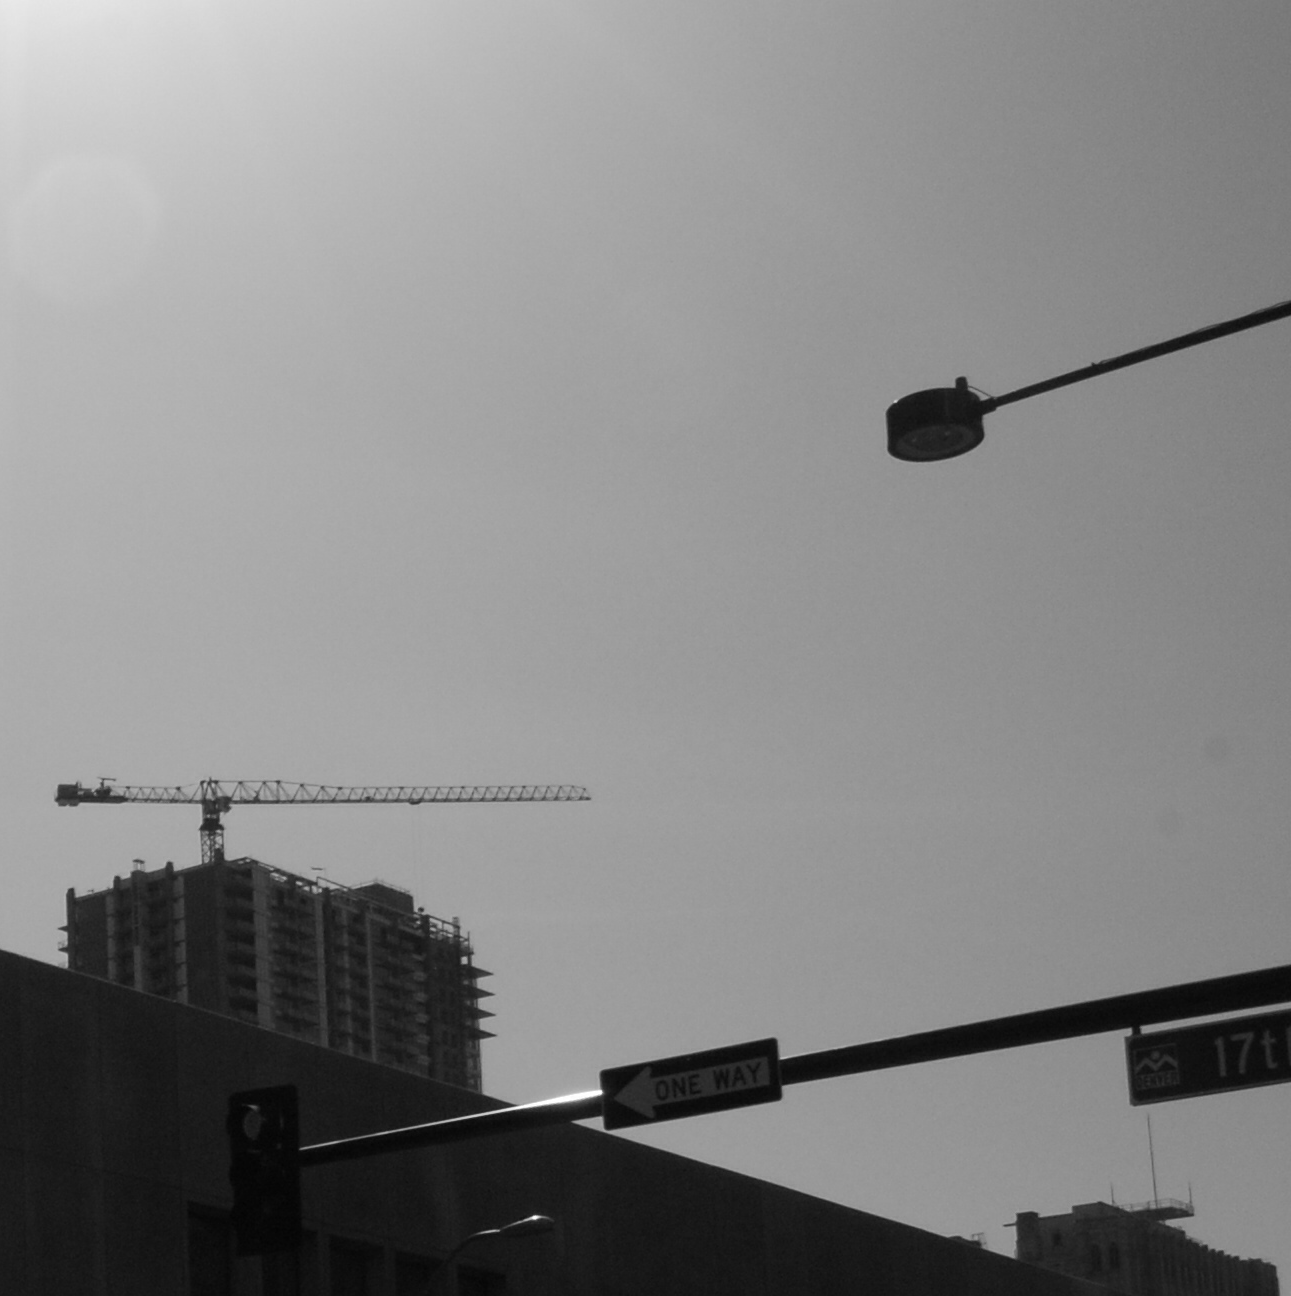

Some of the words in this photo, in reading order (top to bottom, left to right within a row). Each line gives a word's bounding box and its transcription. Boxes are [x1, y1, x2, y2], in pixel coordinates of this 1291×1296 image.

[1214, 1028, 1291, 1077] 17t
[655, 1074, 702, 1101] ONE
[713, 1062, 762, 1091] WAY
